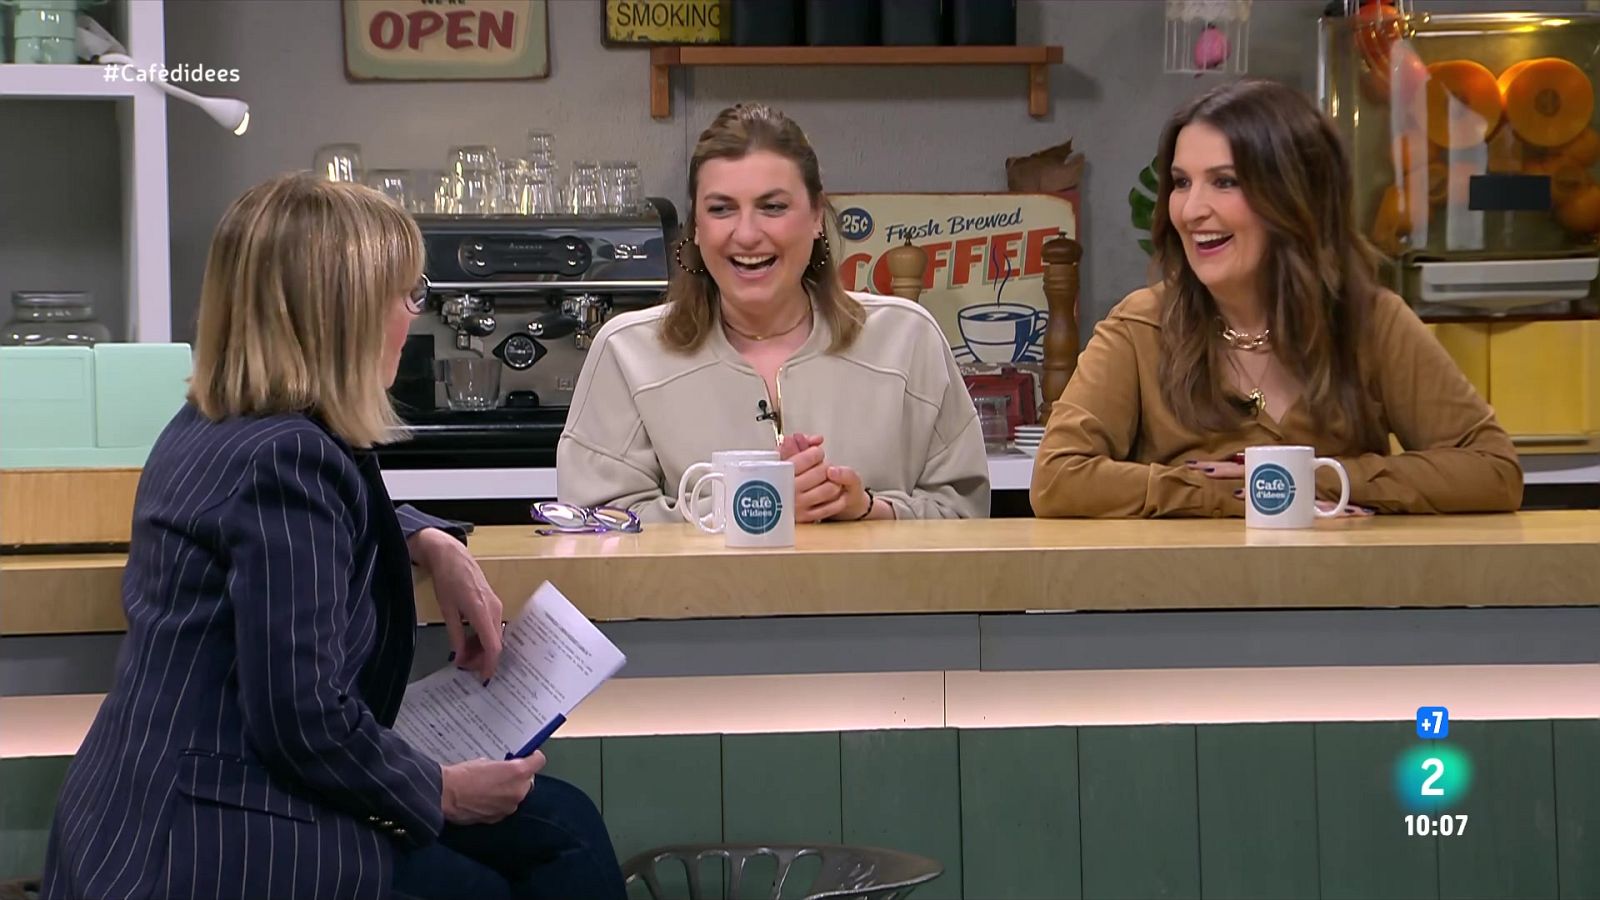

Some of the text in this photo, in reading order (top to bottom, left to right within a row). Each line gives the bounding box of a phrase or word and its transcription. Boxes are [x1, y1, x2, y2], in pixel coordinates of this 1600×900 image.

[369, 10, 515, 49] OPEN
[842, 214, 869, 234] 25¢
[886, 207, 1023, 243] Fresh Brewed
